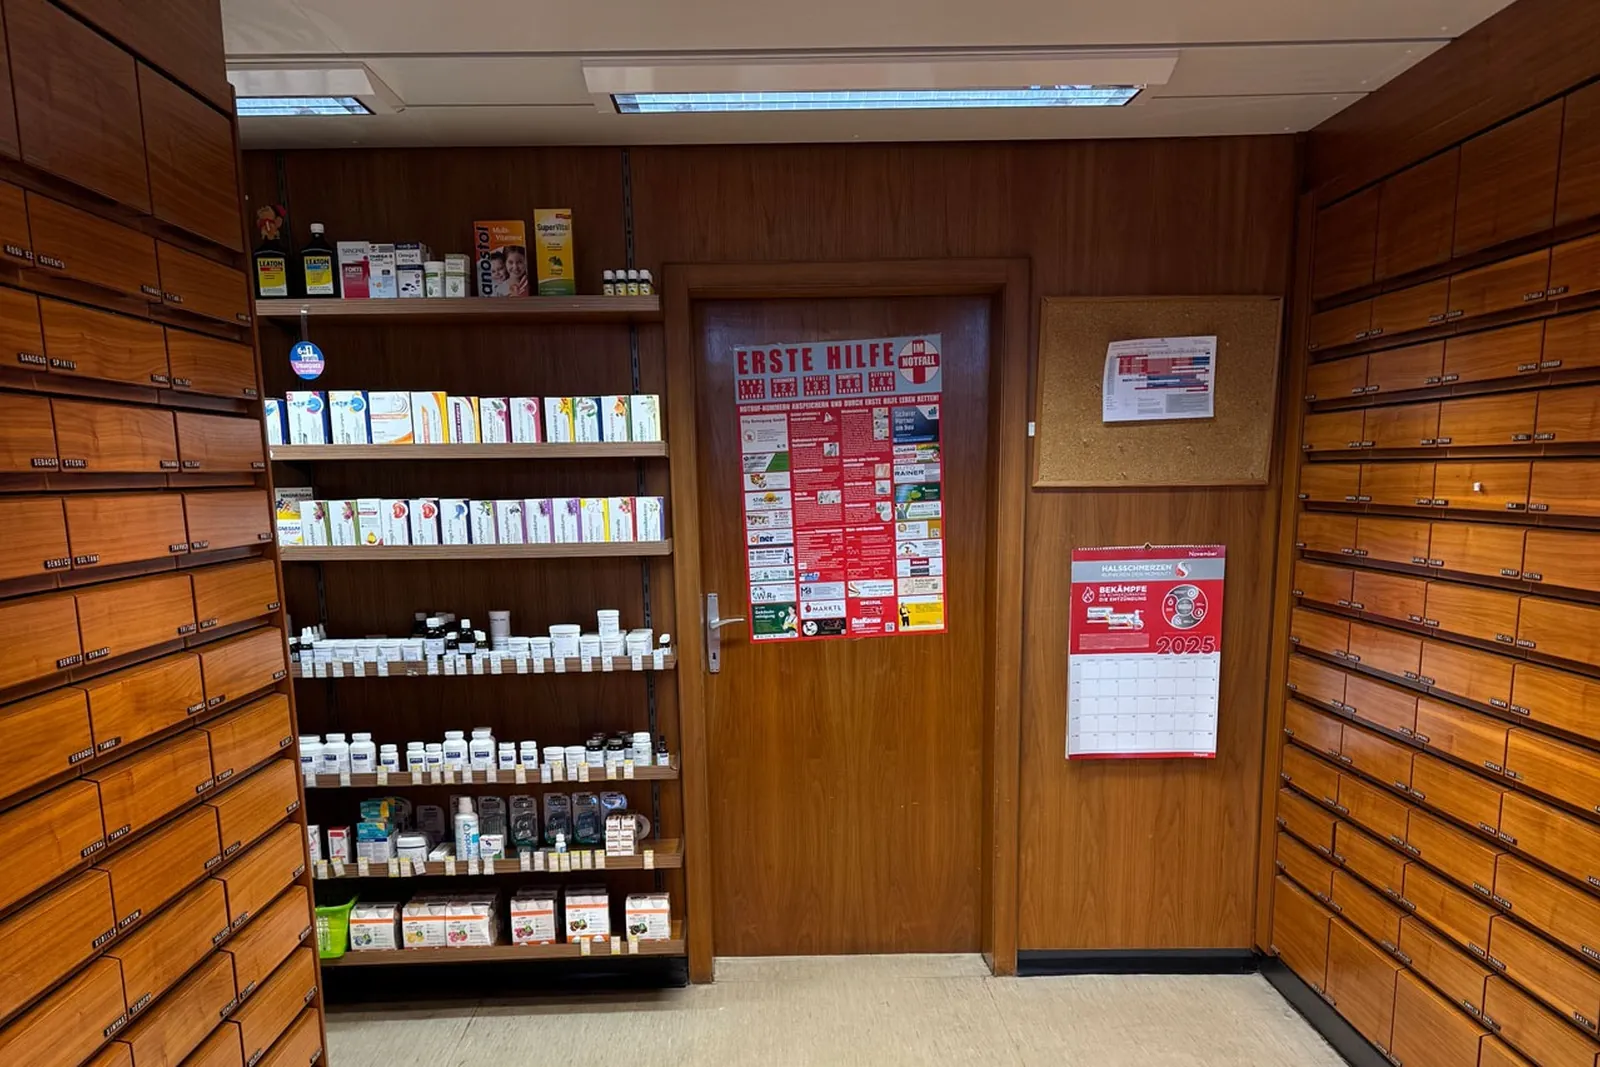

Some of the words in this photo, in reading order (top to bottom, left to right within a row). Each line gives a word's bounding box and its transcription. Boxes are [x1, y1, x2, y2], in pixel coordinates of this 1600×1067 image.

[913, 343, 924, 353] IM
[738, 348, 813, 375] ERSTE
[827, 343, 894, 371] HILFE
[902, 355, 935, 367] NOTFALL
[741, 385, 763, 394] 112
[774, 383, 795, 392] 122
[1102, 564, 1172, 572] HALSSCHMERZEN
[1099, 585, 1147, 593] BEKÄMPFE
[1156, 636, 1215, 654] 2025
